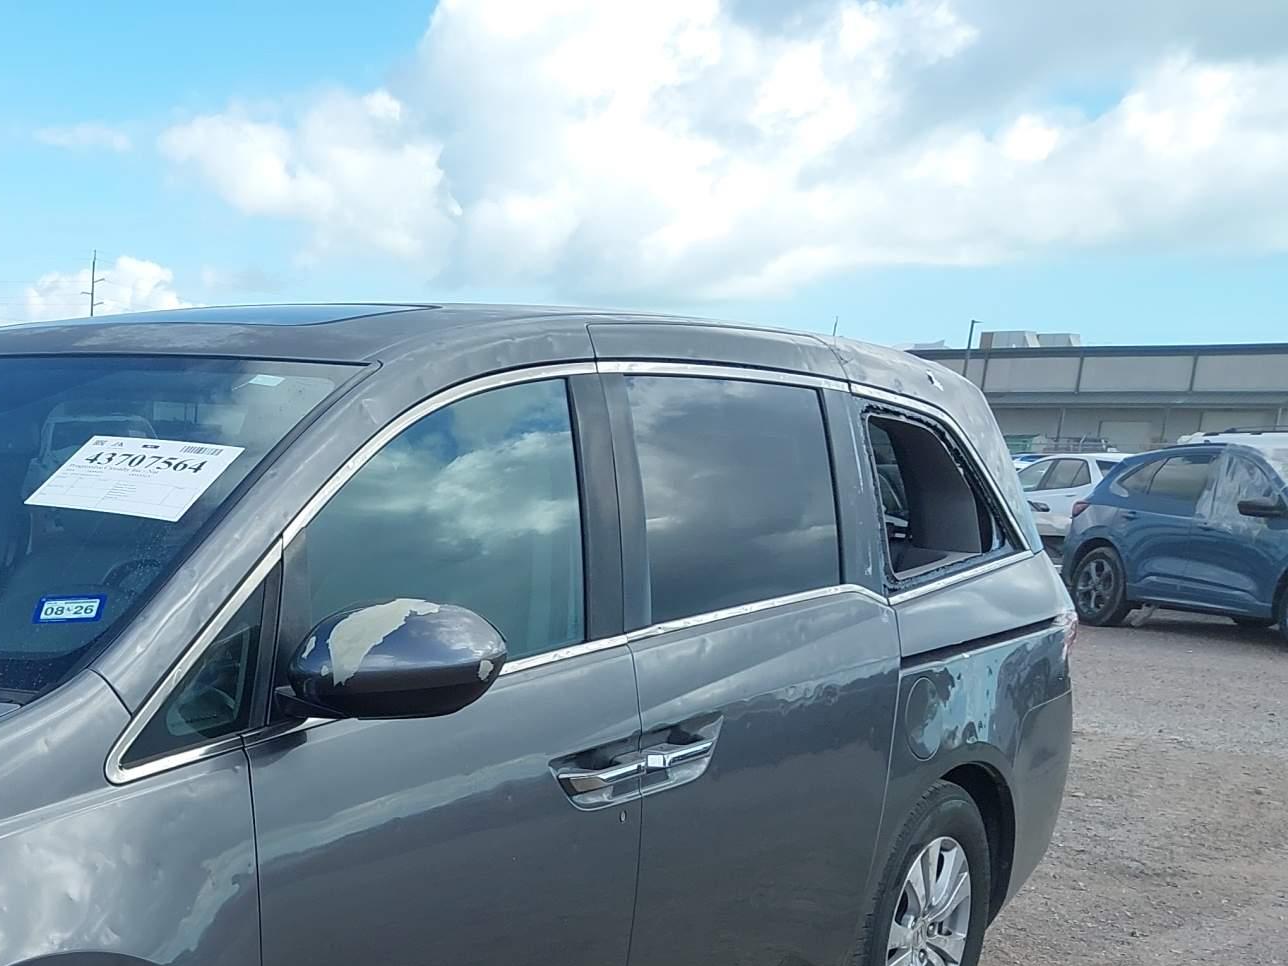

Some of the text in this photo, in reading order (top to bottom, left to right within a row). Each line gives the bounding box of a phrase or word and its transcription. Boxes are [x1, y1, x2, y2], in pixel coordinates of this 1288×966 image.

[85, 451, 207, 474] 43707564
[44, 605, 95, 616] 08 26
